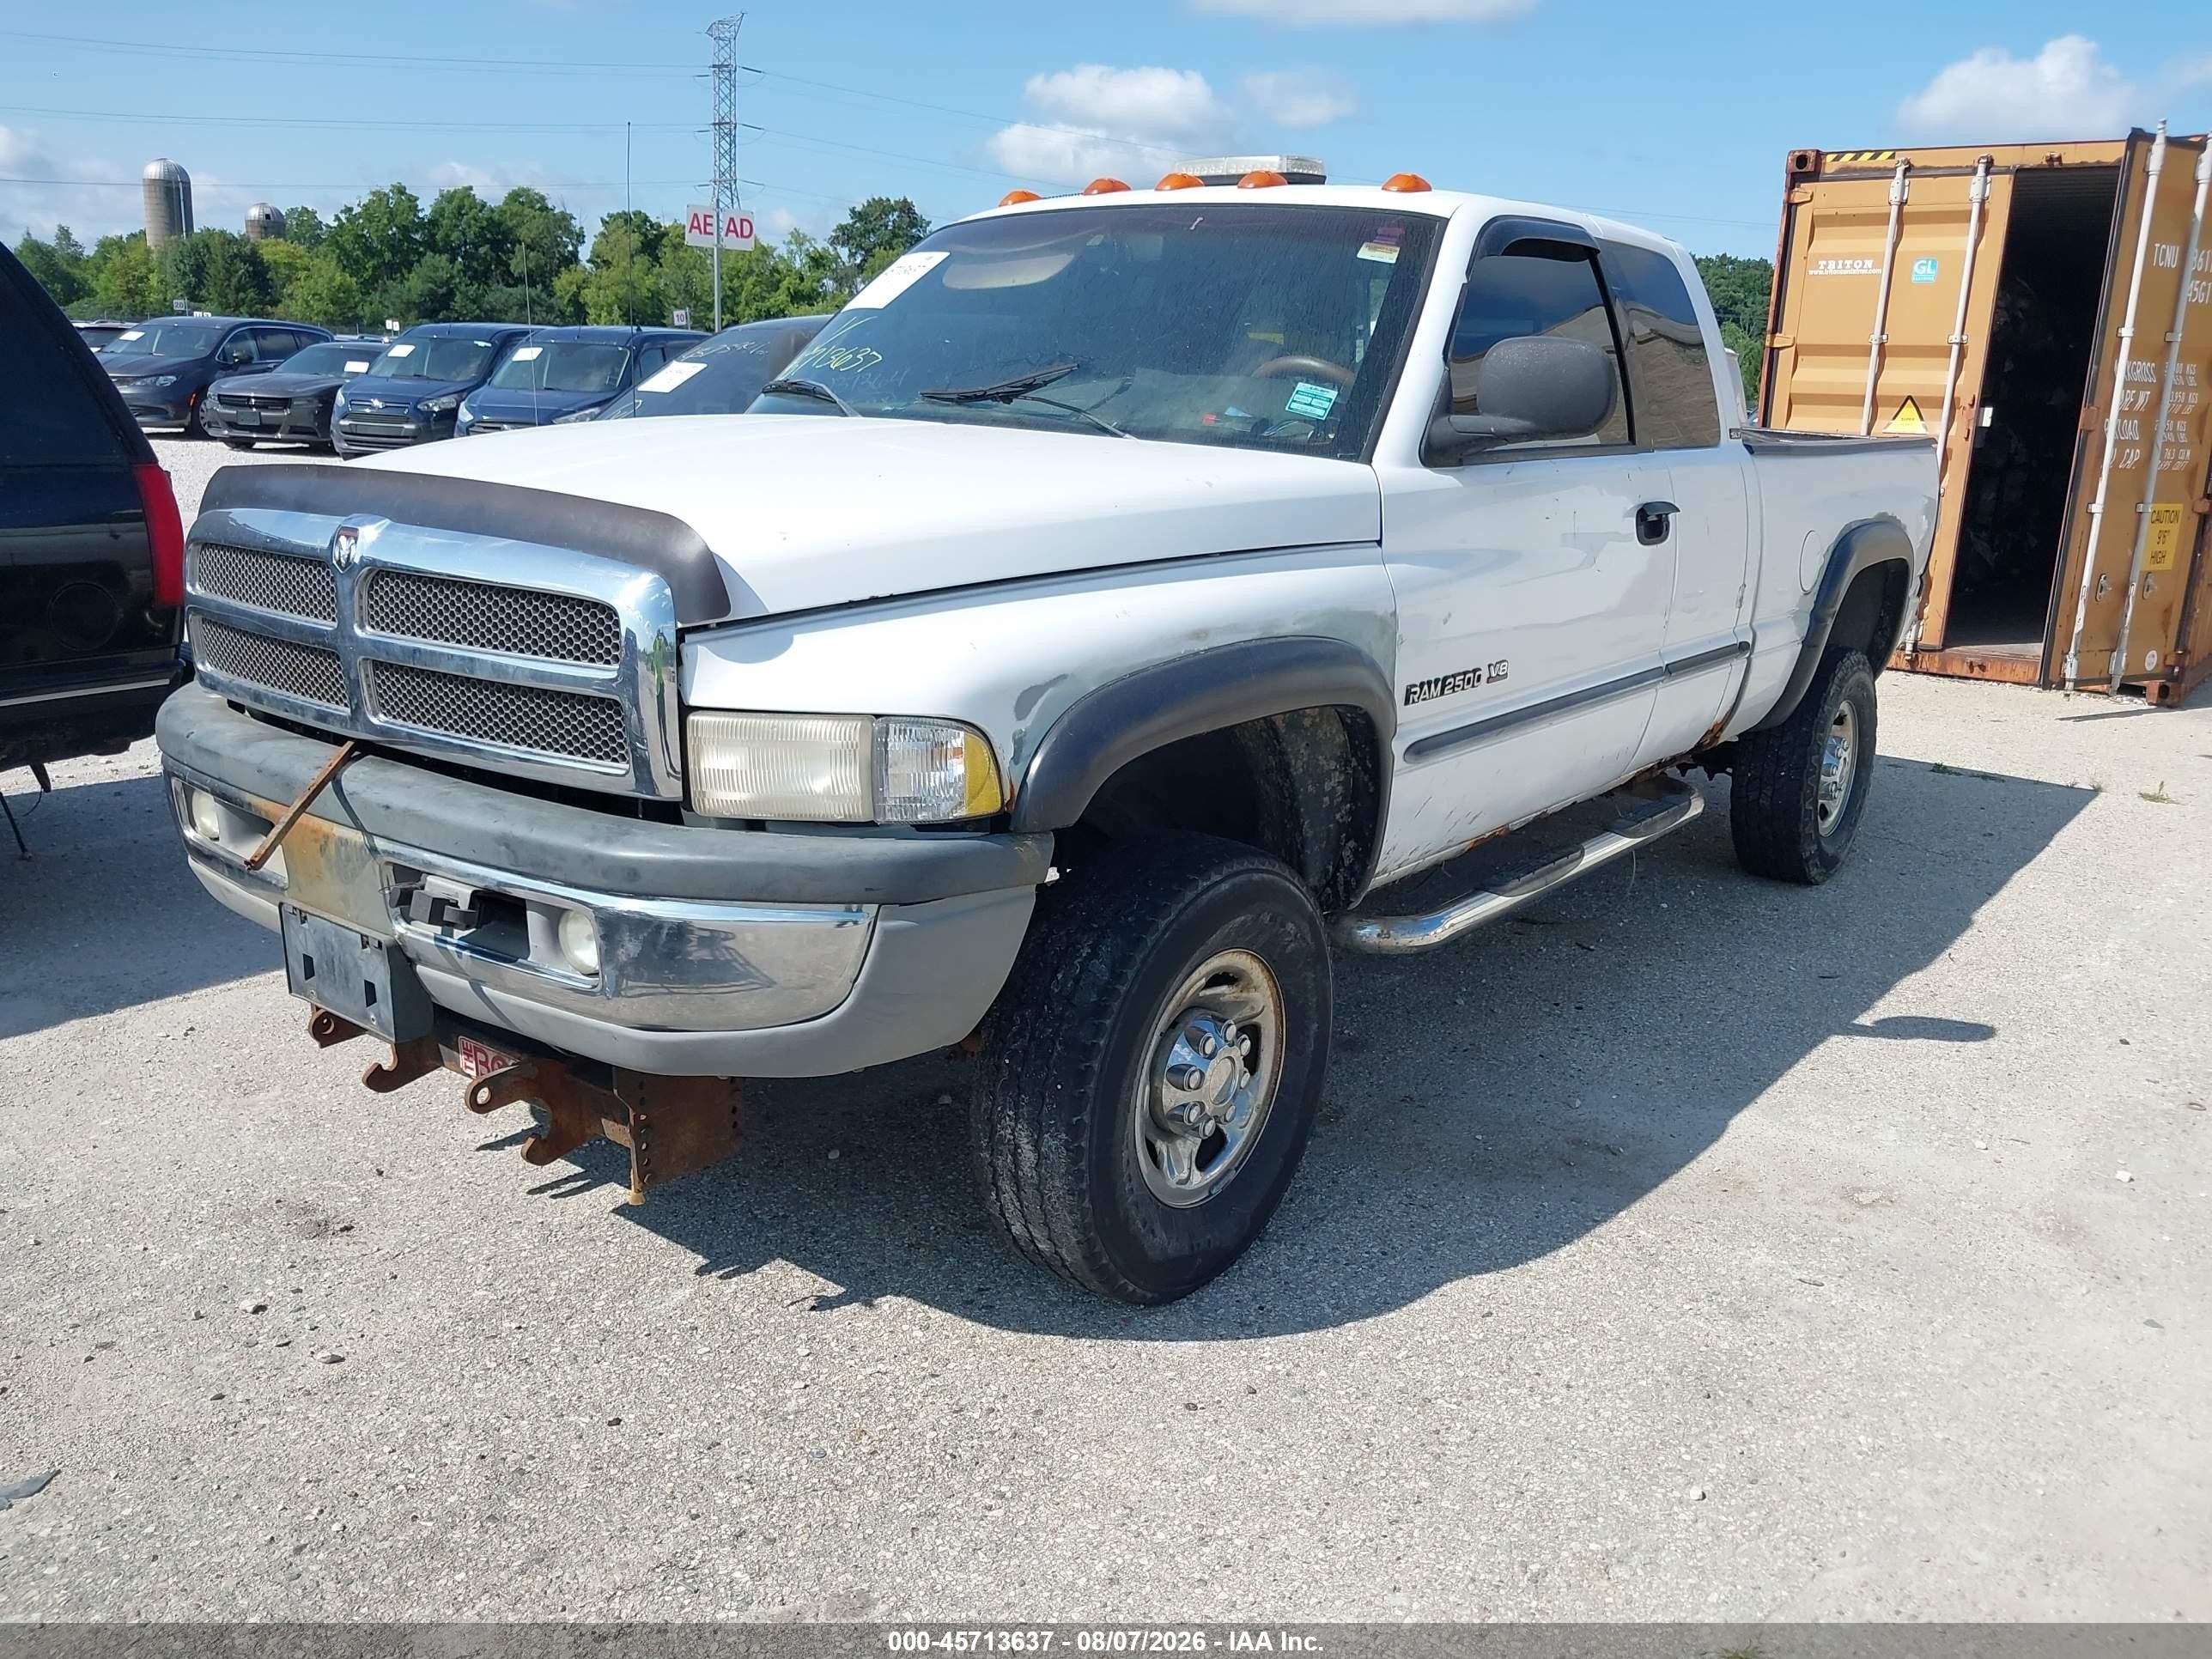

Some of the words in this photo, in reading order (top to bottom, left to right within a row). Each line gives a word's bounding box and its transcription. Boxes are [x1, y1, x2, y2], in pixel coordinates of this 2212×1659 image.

[688, 212, 714, 236] AE
[724, 216, 754, 239] AD
[1818, 259, 1875, 270] TRITON
[2153, 243, 2180, 269] TCNU
[1914, 259, 1936, 275] GL
[676, 313, 685, 323] 10
[2151, 509, 2180, 524] CAUTION
[2150, 550, 2166, 564] HIGH
[1404, 677, 1443, 706] RAM
[1442, 668, 1482, 696] 2500
[1486, 659, 1509, 682] V8
[461, 1040, 475, 1072] THE
